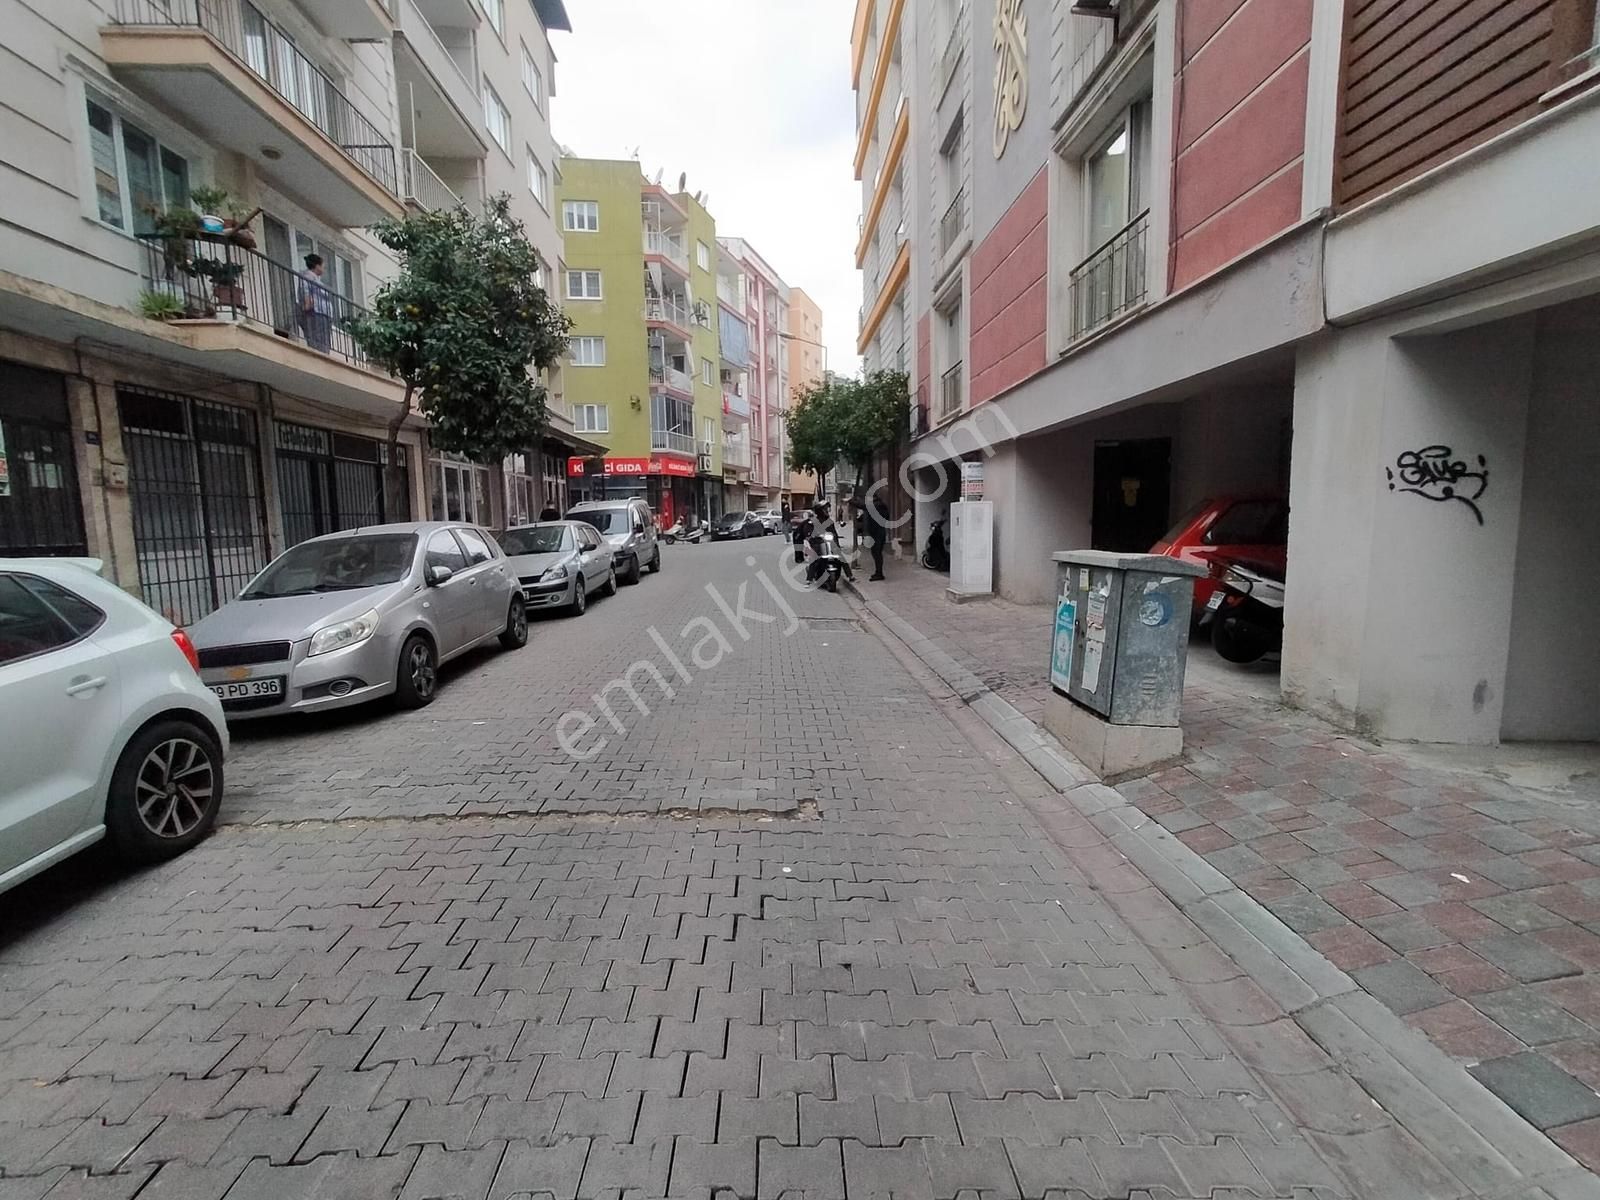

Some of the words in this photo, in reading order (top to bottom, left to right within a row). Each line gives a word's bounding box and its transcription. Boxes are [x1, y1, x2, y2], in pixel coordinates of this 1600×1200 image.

[616, 463, 642, 473] GIDA
[229, 684, 248, 697] PD
[253, 680, 278, 695] 396
